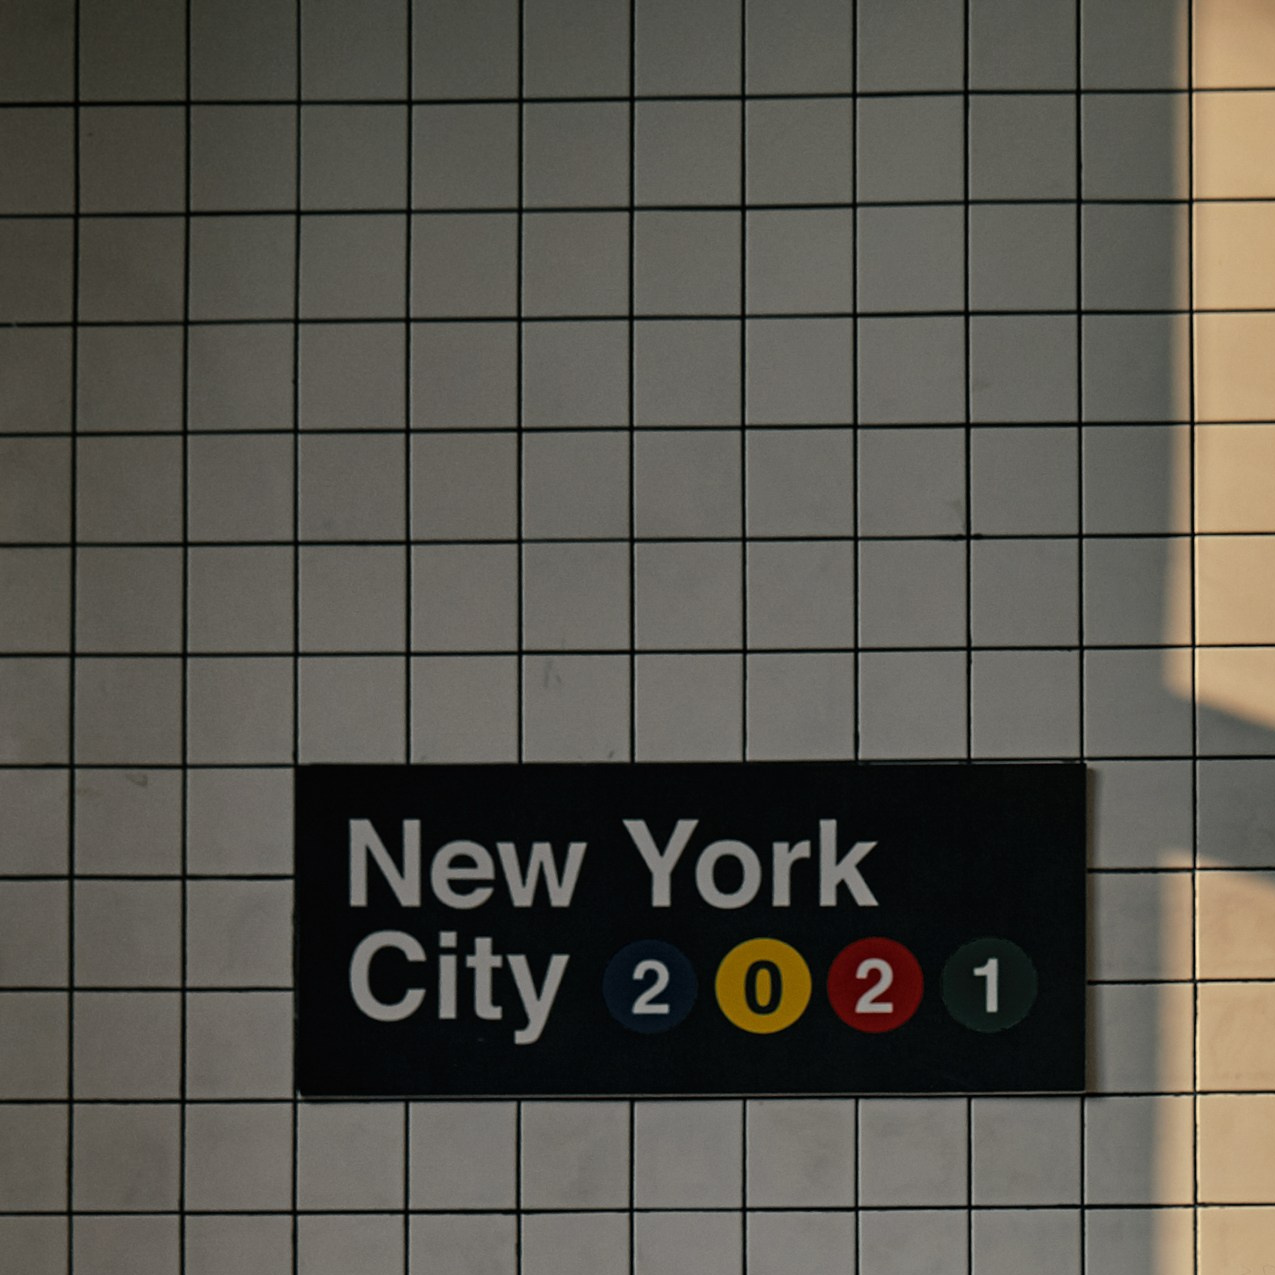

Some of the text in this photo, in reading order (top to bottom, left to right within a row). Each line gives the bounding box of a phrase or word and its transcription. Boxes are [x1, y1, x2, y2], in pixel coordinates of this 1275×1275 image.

[349, 819, 879, 909] New York
[350, 930, 999, 1045] City 2 0 2 1
